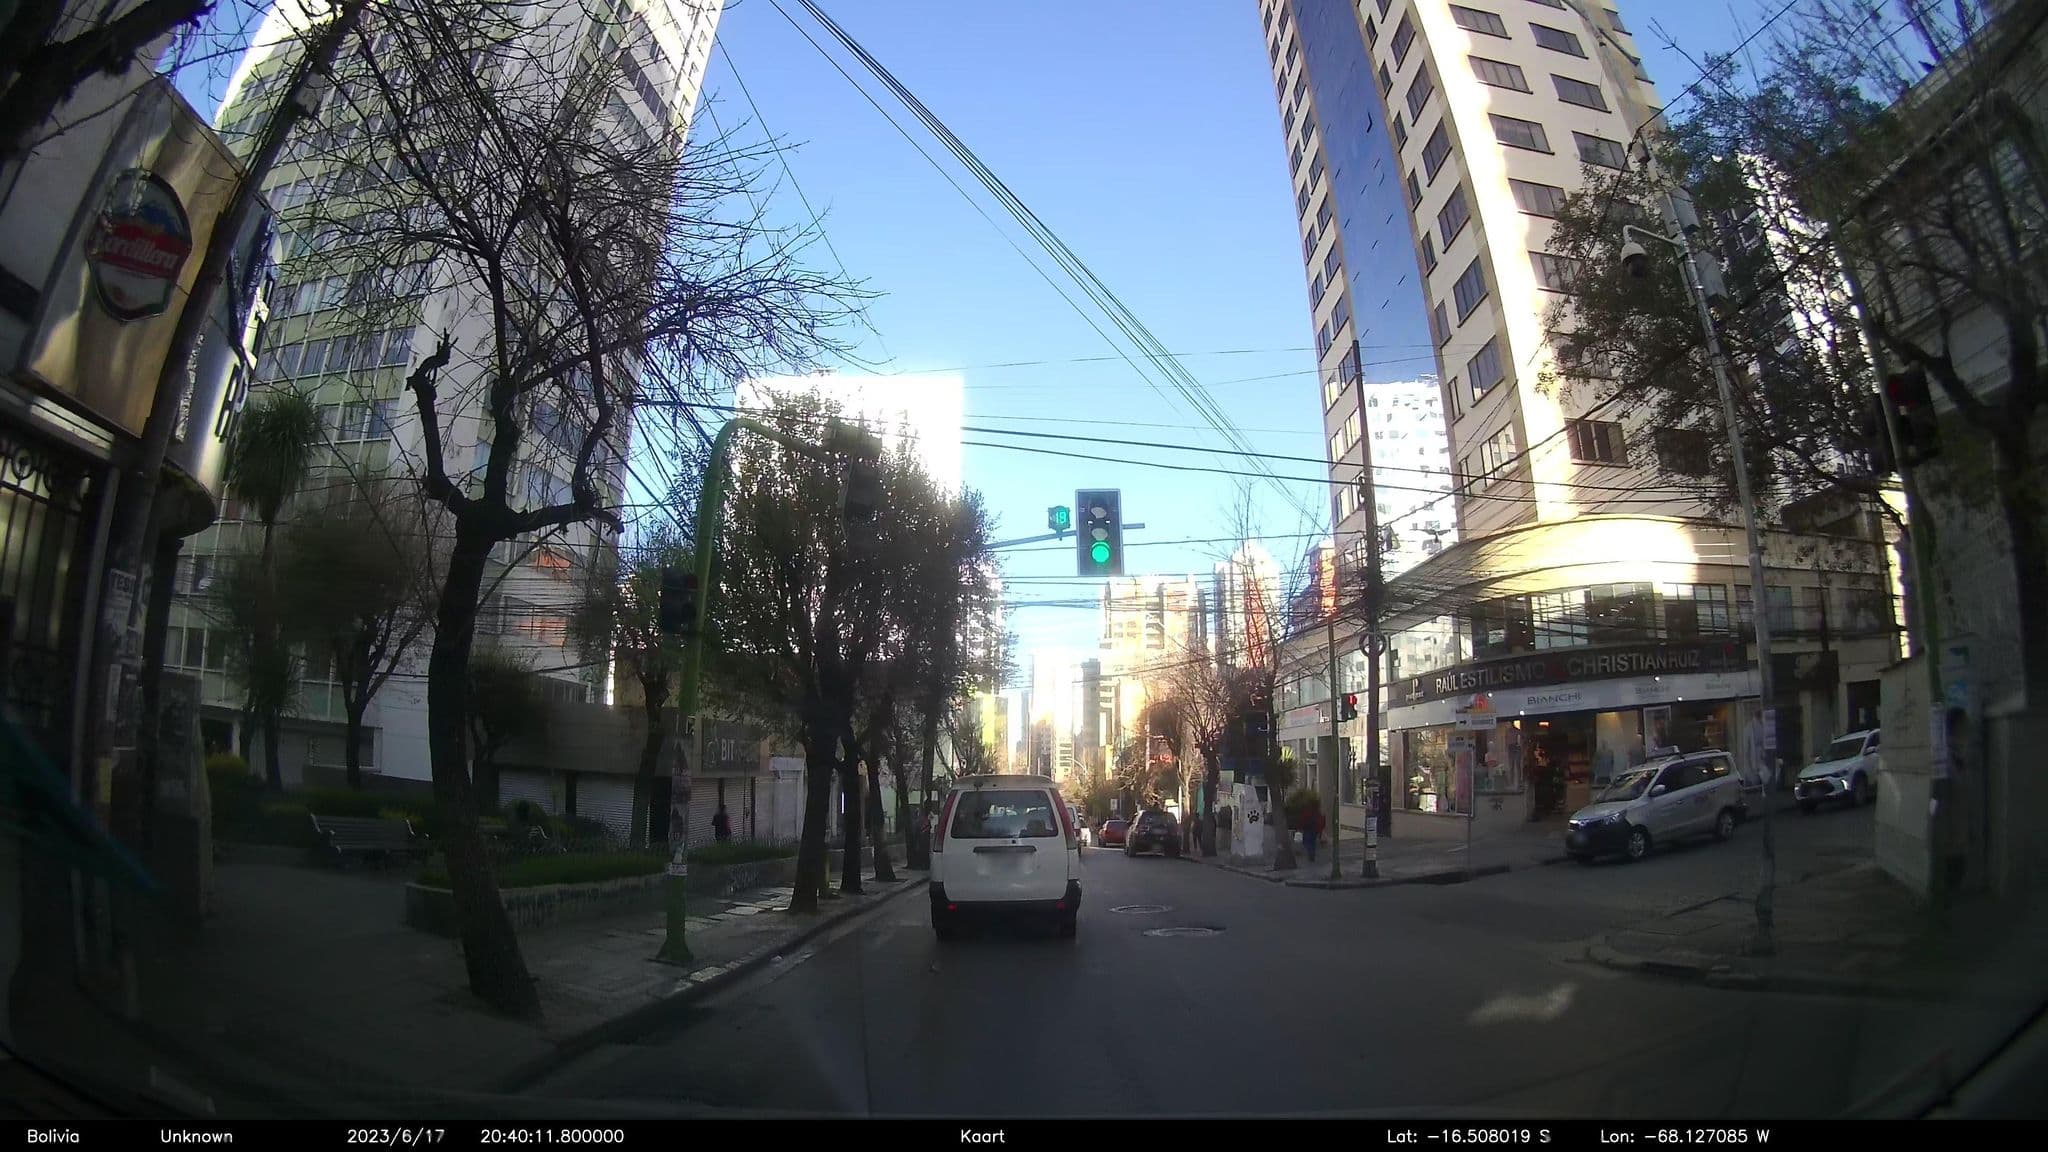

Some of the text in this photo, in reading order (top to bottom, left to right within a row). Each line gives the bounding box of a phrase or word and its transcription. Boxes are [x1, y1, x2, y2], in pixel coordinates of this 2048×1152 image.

[1435, 671, 1458, 694] RAÚL
[1460, 661, 1545, 688] ESTILISMO
[1567, 650, 1667, 676] CHRISTIAN
[1669, 650, 1699, 668] RUIZ
[1527, 691, 1583, 705] BIANCHI
